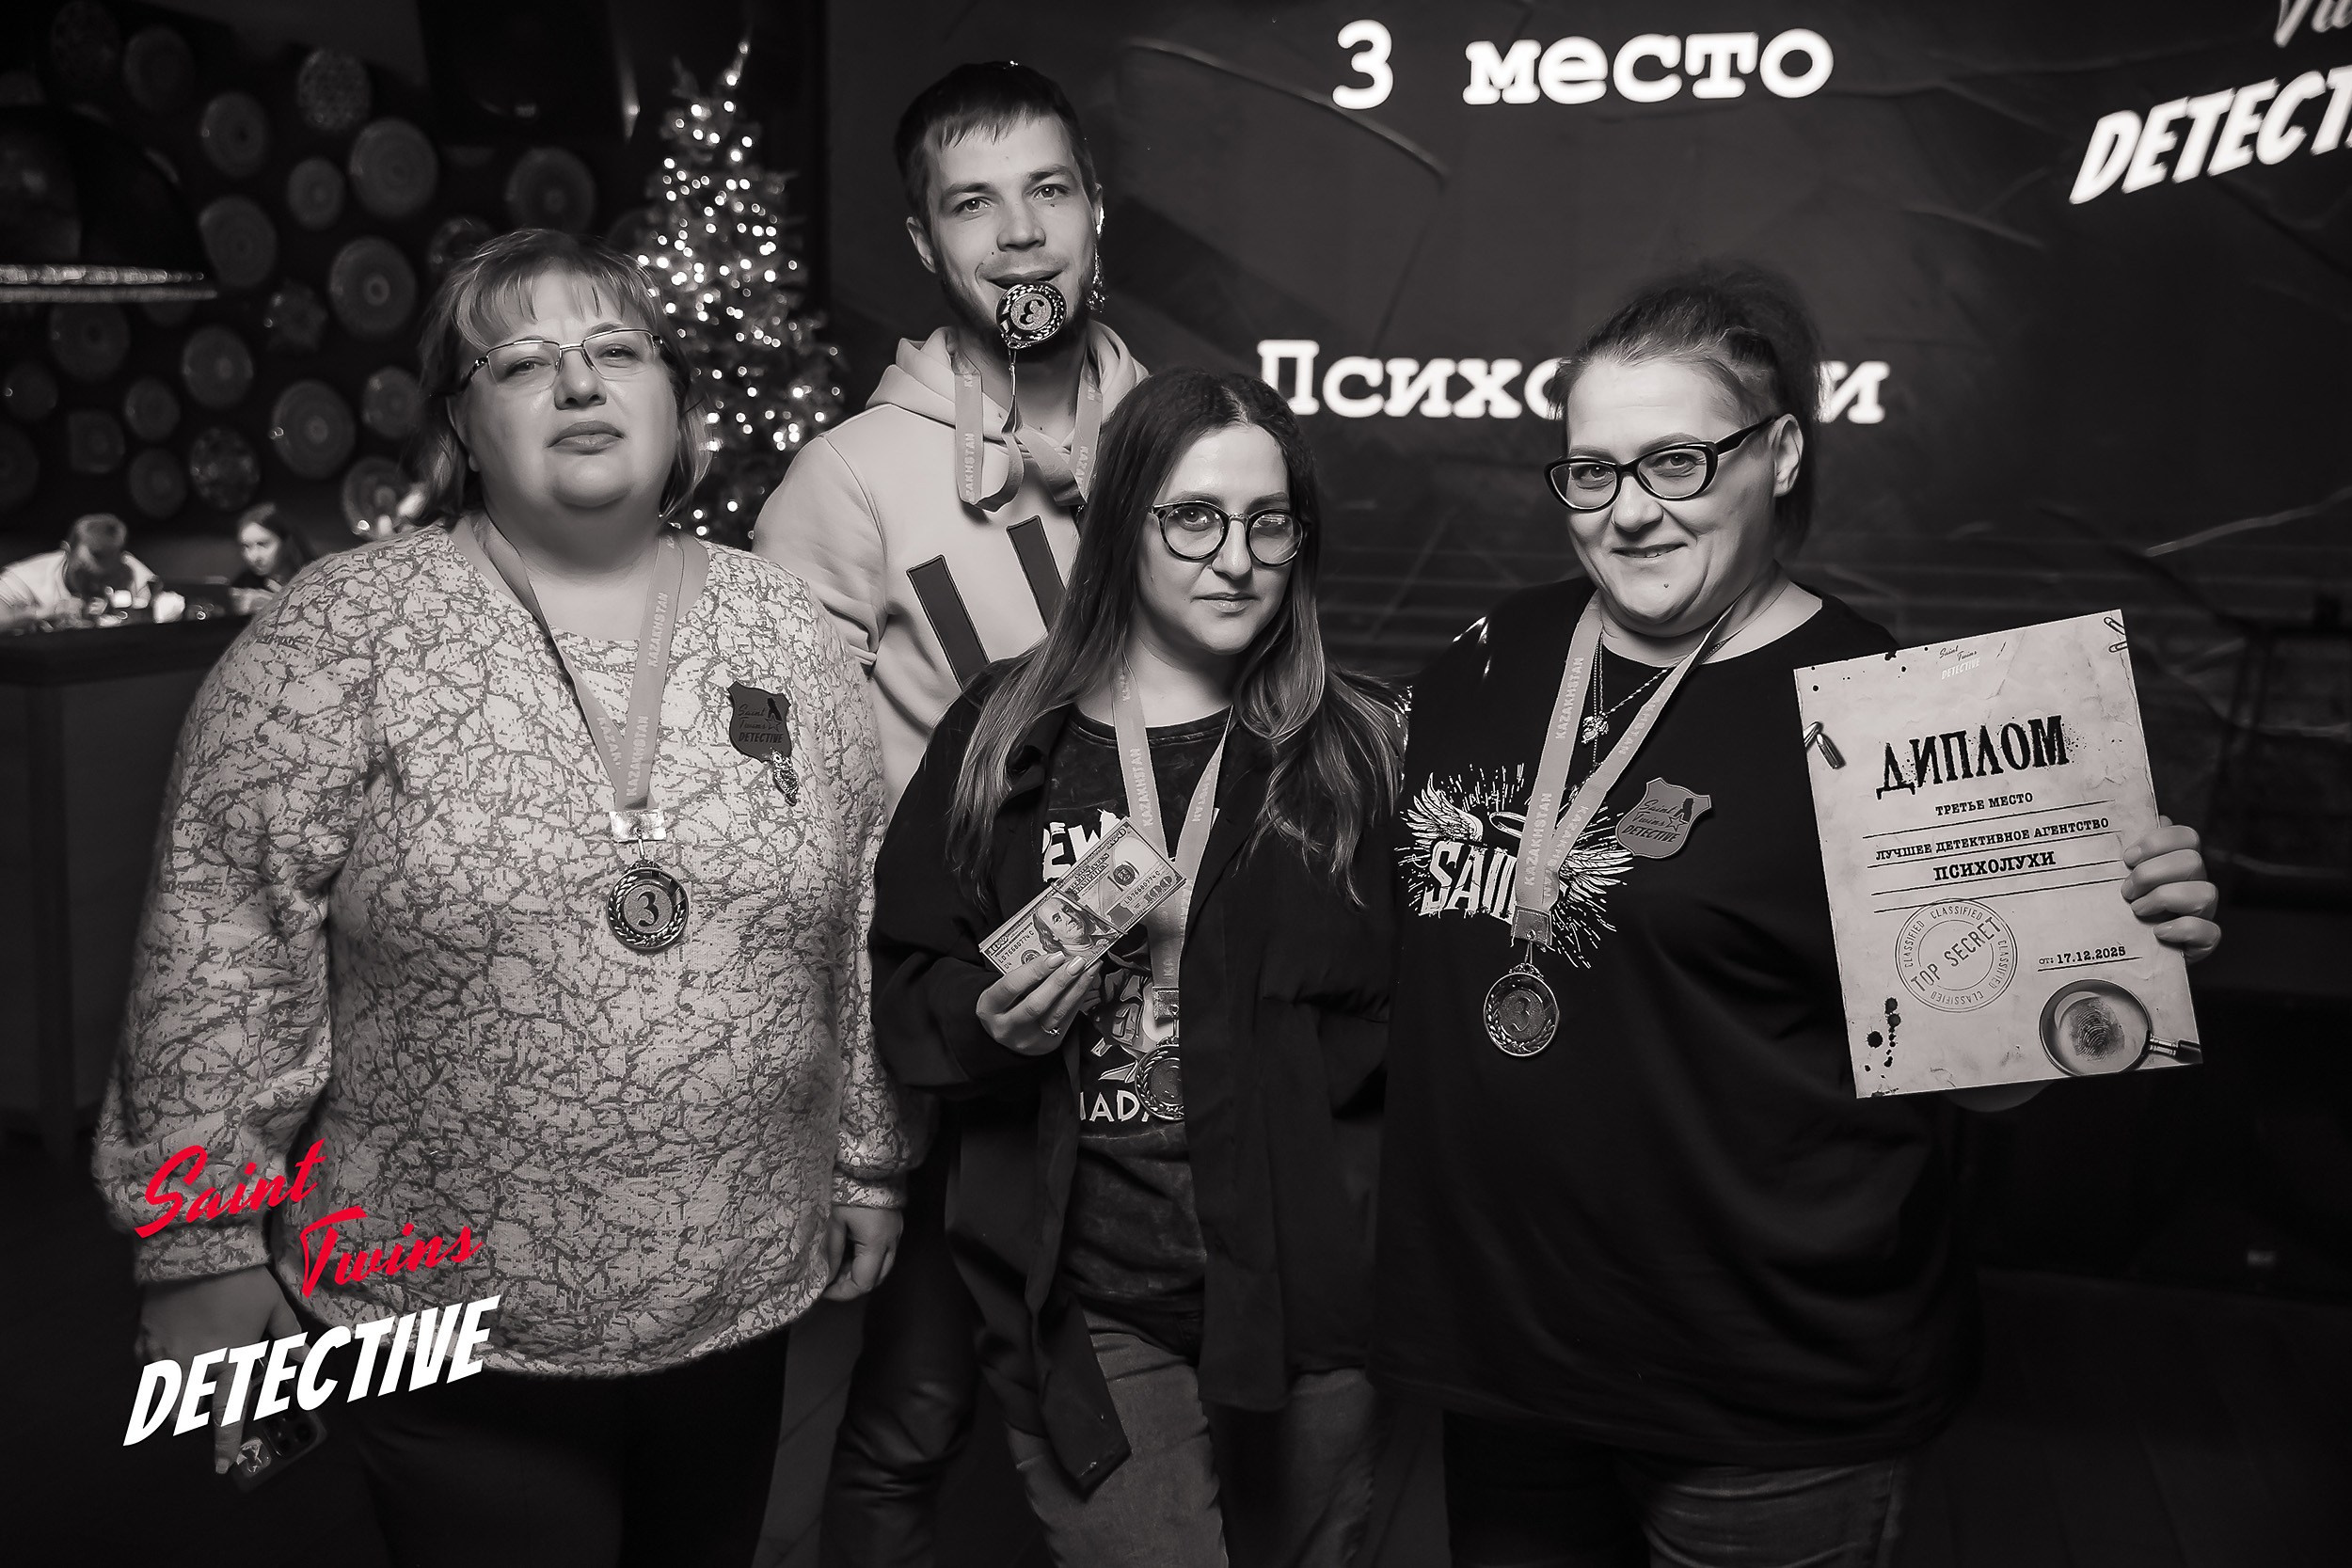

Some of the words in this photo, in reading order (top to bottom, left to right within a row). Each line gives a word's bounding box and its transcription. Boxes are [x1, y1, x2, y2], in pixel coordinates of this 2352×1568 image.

[1332, 19, 1393, 110] 3
[1463, 27, 1834, 105] место
[2071, 64, 2352, 204] DETECT
[1555, 657, 1584, 739] KAZAKHSTAN
[626, 715, 649, 797] KAZAKHSTAN
[739, 733, 784, 743] DETECTIVE
[1876, 715, 2070, 800] ДИПЛОМ
[1632, 812, 1665, 826] Twins
[1639, 799, 1677, 814] Saint
[1935, 800, 1985, 816] ТРЕТЬЕ
[1989, 792, 2033, 808] МЕСТО
[1524, 793, 1552, 886] KAZAKHSTAN
[1621, 825, 1680, 842] DETECTIVE
[1876, 843, 1932, 861] ЛУЧШЕЕ
[1936, 829, 2030, 853] ДЕТЕКТИВНОЕ
[2034, 817, 2109, 838] АГЕНТСТВО
[1933, 851, 2056, 880] ПСИХОЛУХИ
[637, 891, 660, 927] 3
[1930, 906, 1983, 921] CLASSIFIED
[1903, 920, 1925, 968] CLASSIFIED
[1910, 963, 1941, 992] TOP
[1944, 916, 2001, 967] SECRET
[2057, 946, 2126, 964] 17.12.2025
[1988, 940, 2010, 990] CLASSIFIED
[1930, 990, 1984, 1006] CLASSIFIED
